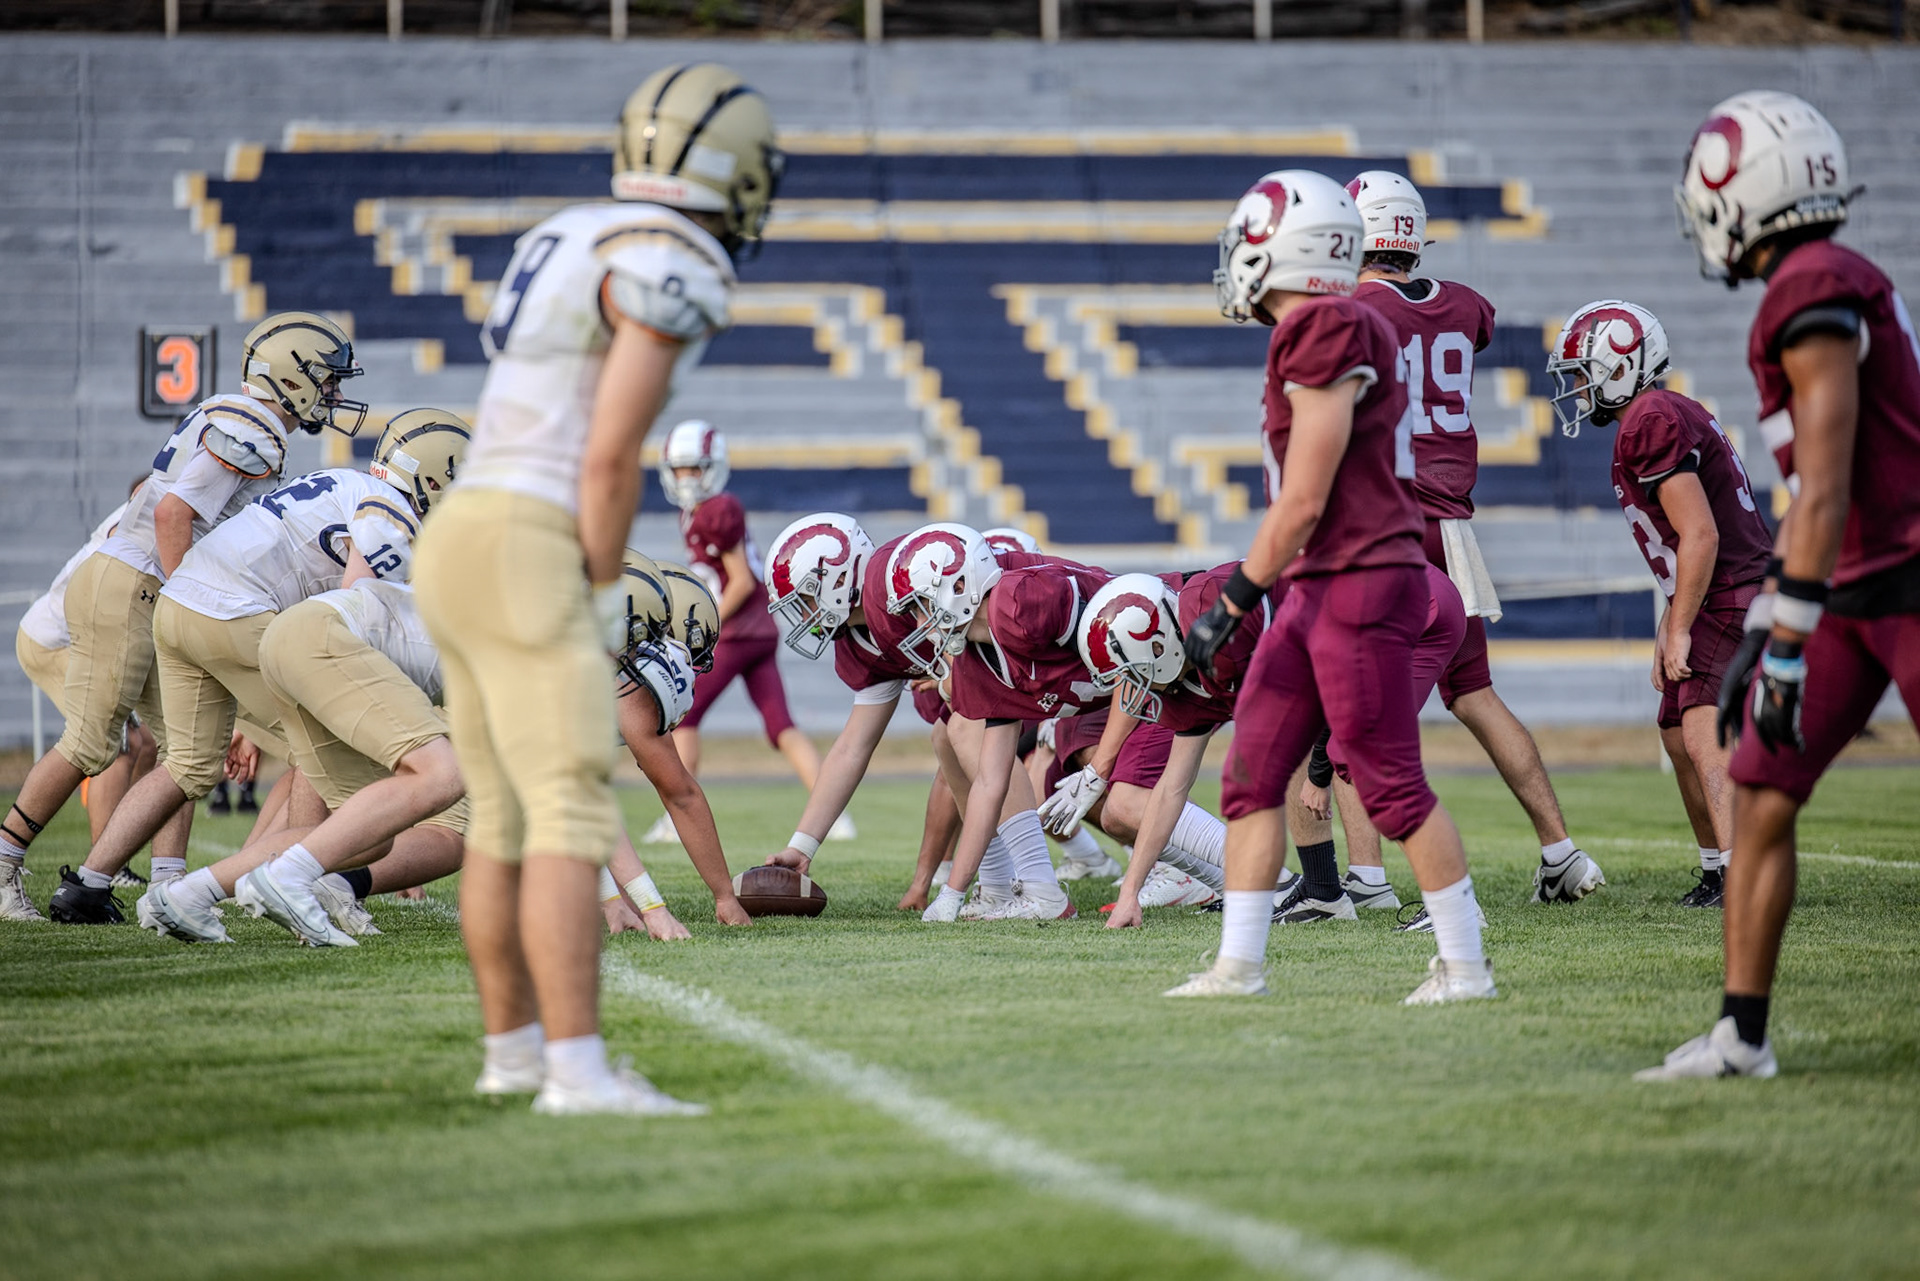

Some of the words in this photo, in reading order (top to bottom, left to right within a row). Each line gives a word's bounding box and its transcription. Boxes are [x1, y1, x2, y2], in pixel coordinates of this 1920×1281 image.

[1805, 153, 1837, 189] 15
[1393, 214, 1414, 237] 19
[1329, 232, 1355, 261] 21
[1375, 237, 1420, 252] Riddell
[155, 335, 200, 404] 3
[1403, 331, 1475, 435] 19
[363, 543, 402, 579] 12
